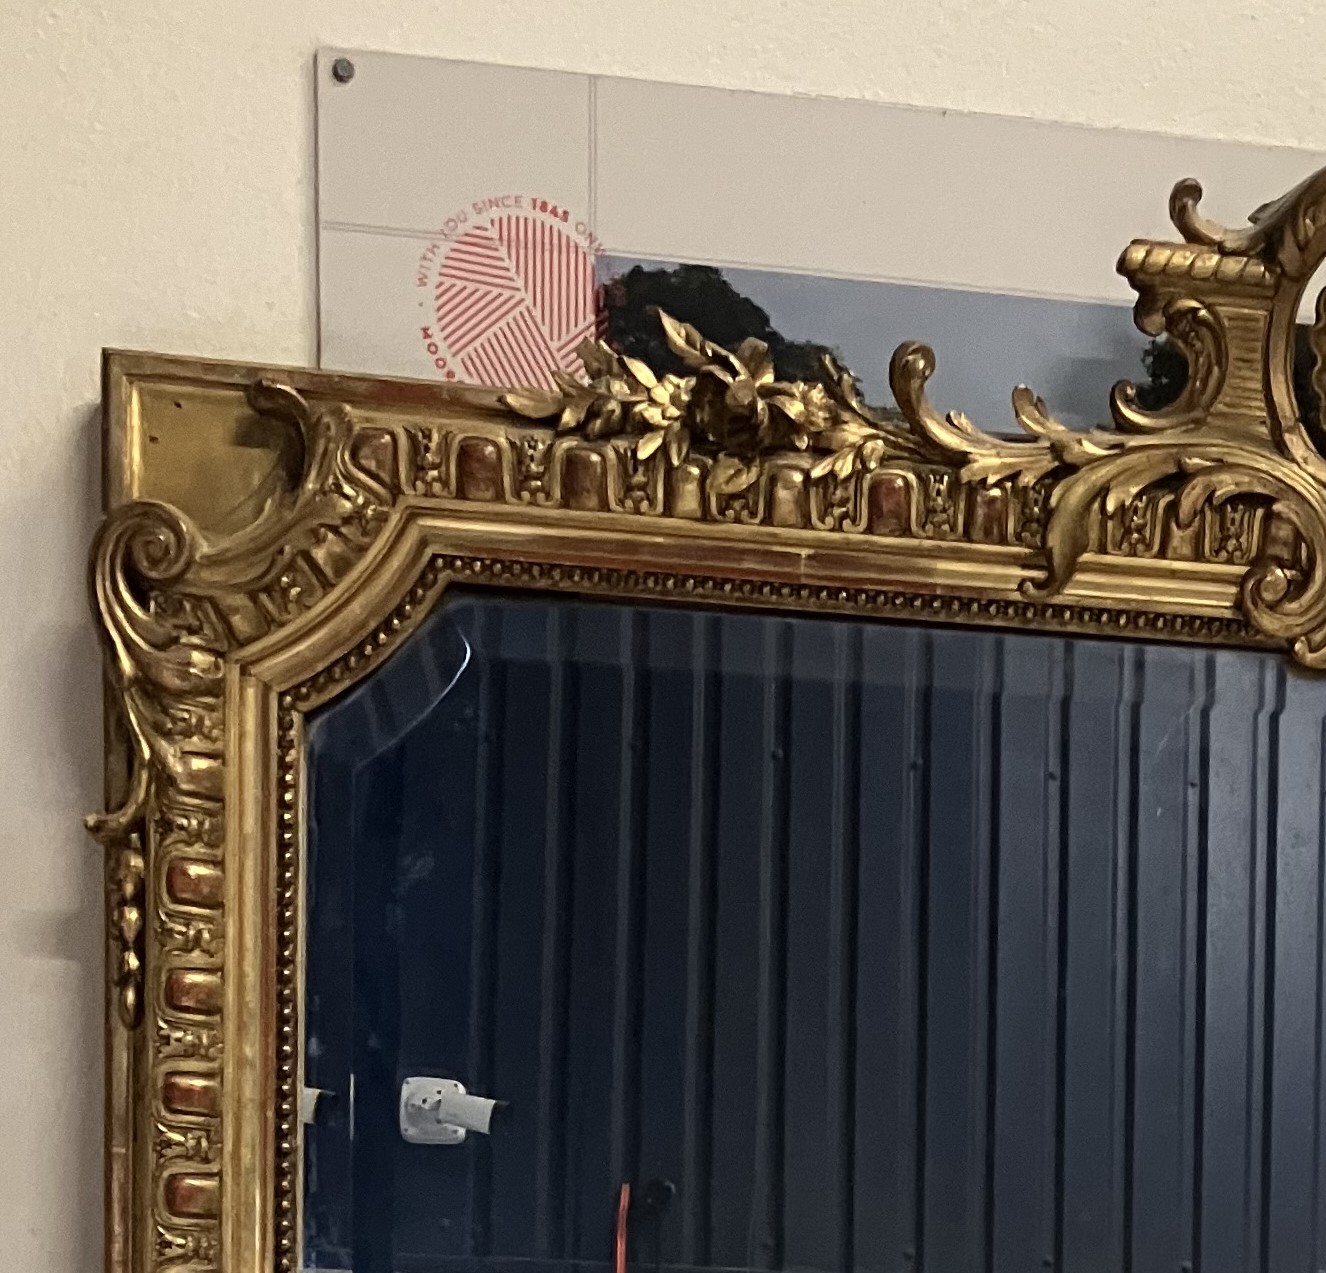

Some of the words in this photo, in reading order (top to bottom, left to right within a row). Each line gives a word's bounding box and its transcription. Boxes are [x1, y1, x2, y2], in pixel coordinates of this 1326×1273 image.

[415, 242, 441, 288] WITH
[439, 210, 468, 239] YOU
[472, 196, 524, 215] SINCE
